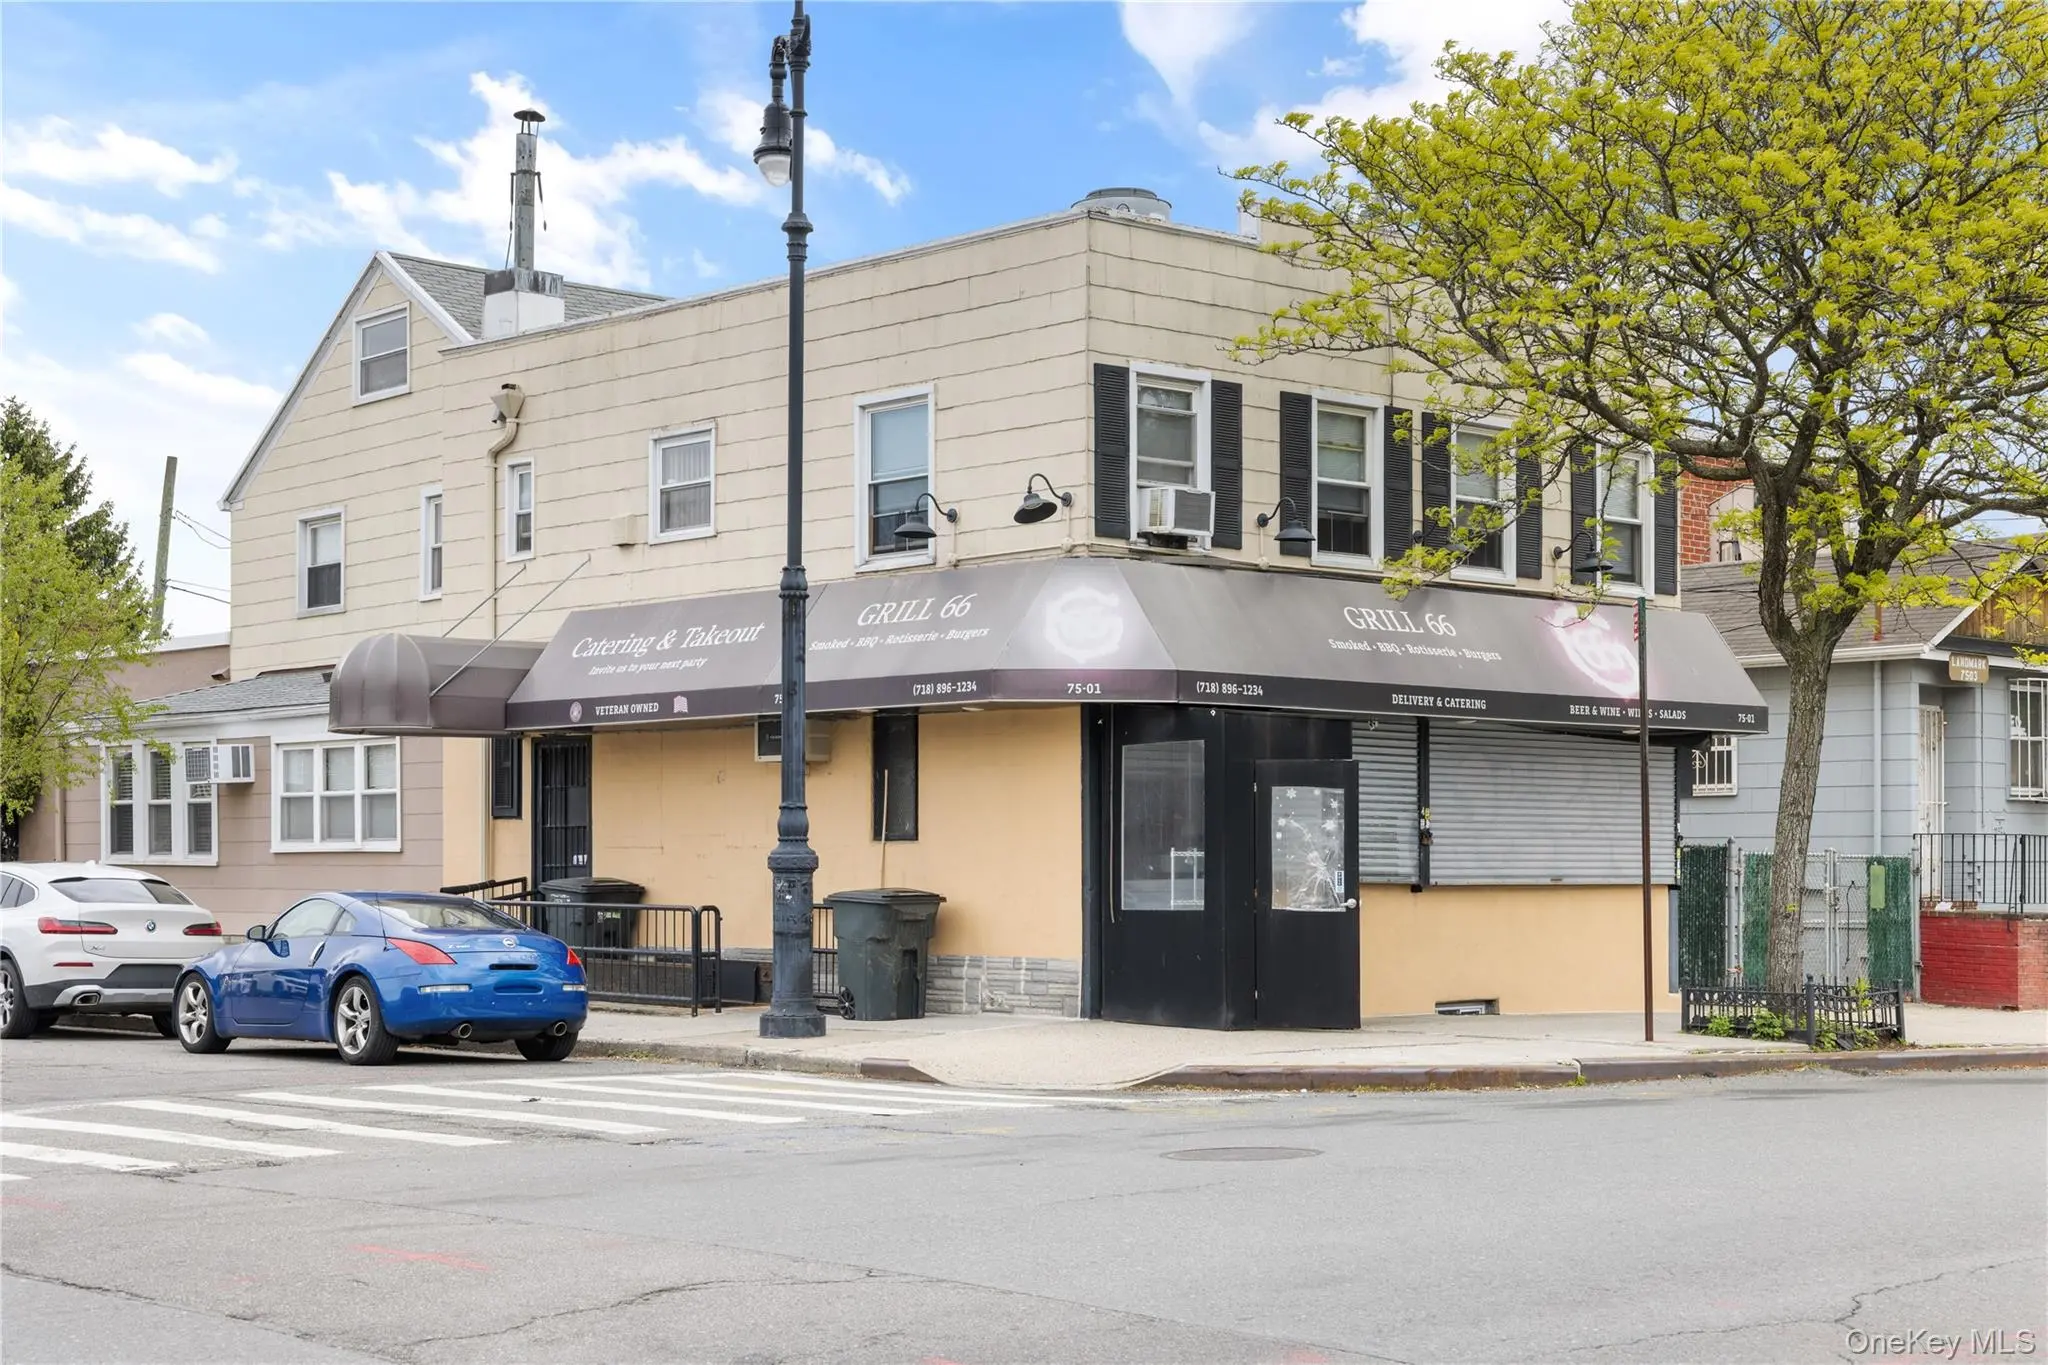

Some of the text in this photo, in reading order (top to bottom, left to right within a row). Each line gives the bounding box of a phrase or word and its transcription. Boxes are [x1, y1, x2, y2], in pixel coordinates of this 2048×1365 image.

[857, 593, 978, 626] GRILL 66
[1343, 606, 1456, 636] GRILL 66
[572, 622, 765, 658] Catering & Takeout
[809, 628, 990, 651] Smoked BBQ Rotisserie Burgers
[1328, 638, 1502, 662] Smoked BBQ Rotisserie Burgers
[589, 658, 708, 675] Invite us to your next party
[913, 681, 977, 696] (718) 896-1234
[1067, 683, 1102, 694] 75-01
[1196, 681, 1263, 696] (718) 896-1234
[595, 704, 629, 716] VETERAN
[631, 703, 659, 714] OWNED
[1392, 694, 1486, 710] DELIVERY & CATERING
[1570, 705, 1686, 720] BEER & WINE WIS SALADS
[1738, 713, 1755, 724] 75-01
